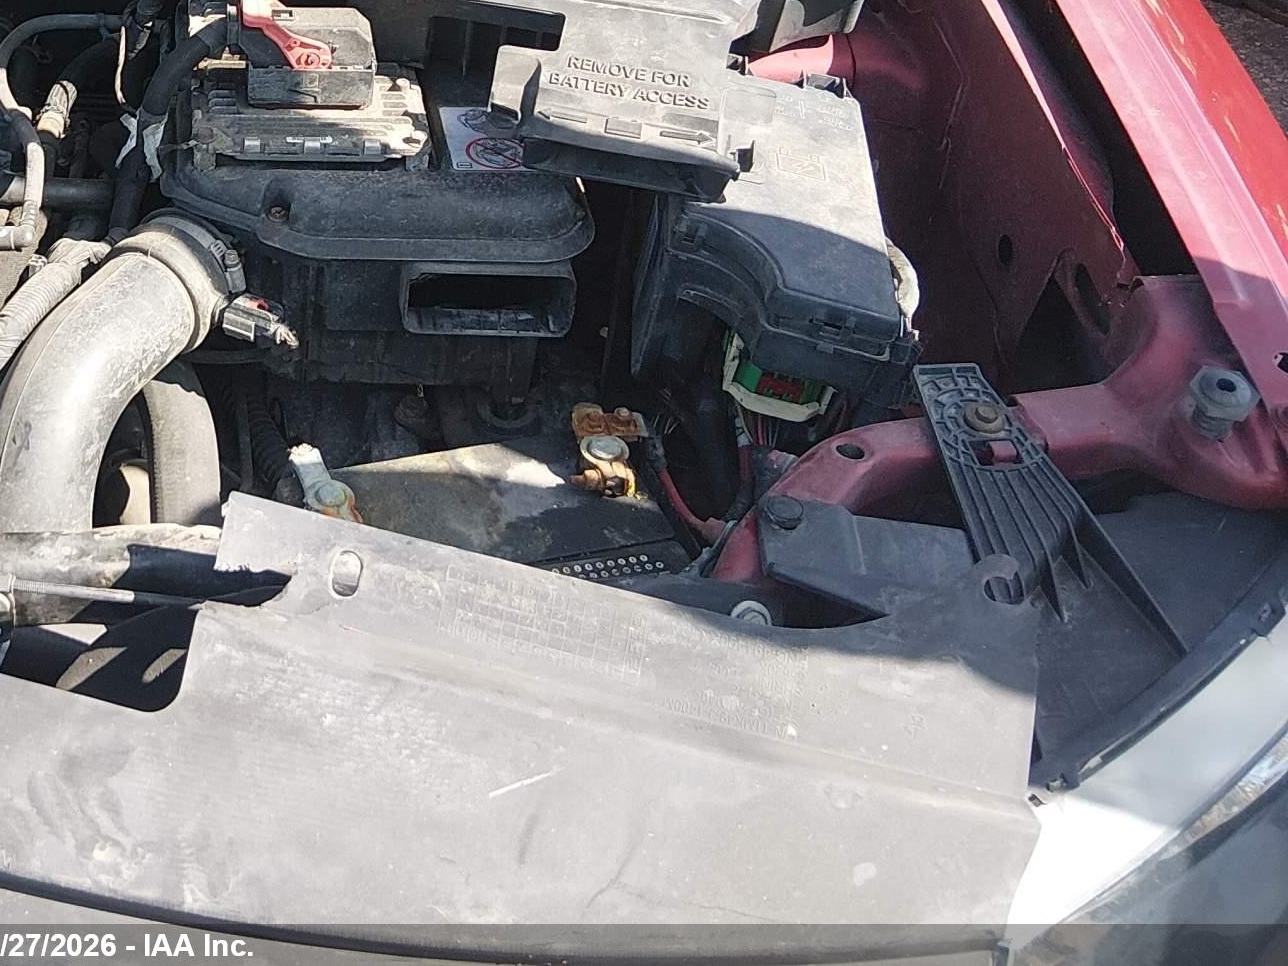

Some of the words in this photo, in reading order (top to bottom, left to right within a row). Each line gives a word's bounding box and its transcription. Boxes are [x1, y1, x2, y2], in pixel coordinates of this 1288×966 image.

[567, 54, 647, 82] REMOVE
[650, 70, 691, 88] FOR
[548, 72, 628, 98] BATTERY
[633, 89, 711, 110] ACCESS
